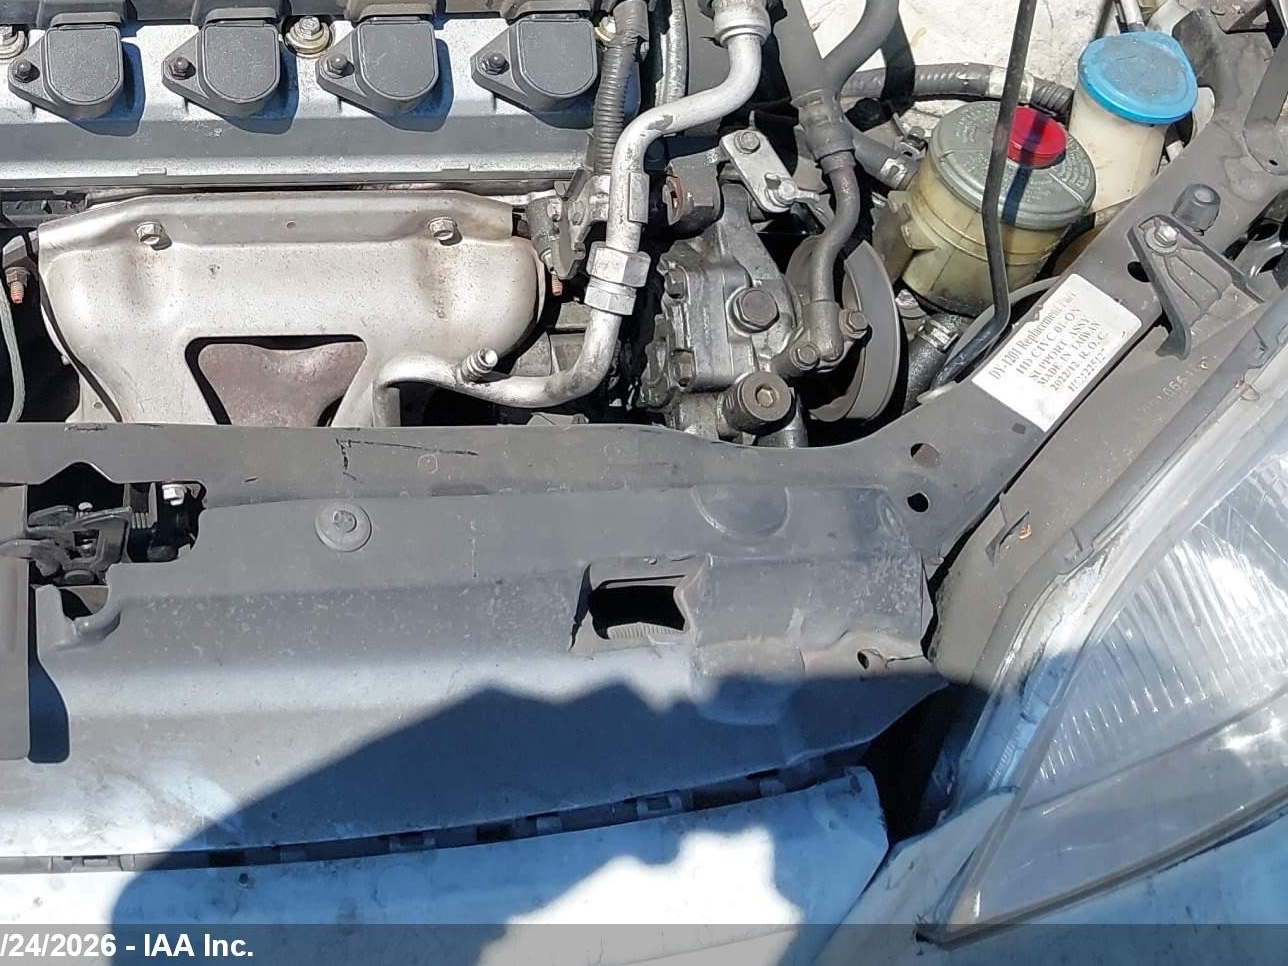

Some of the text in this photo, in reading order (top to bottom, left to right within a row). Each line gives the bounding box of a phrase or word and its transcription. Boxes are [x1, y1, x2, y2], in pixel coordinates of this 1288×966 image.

[988, 344, 1022, 381] DY-1201
[1017, 305, 1061, 353] Replacement
[1027, 338, 1069, 383] SUPPORT
[1036, 360, 1062, 388] MADE
[1069, 318, 1101, 352] TAIWAN
